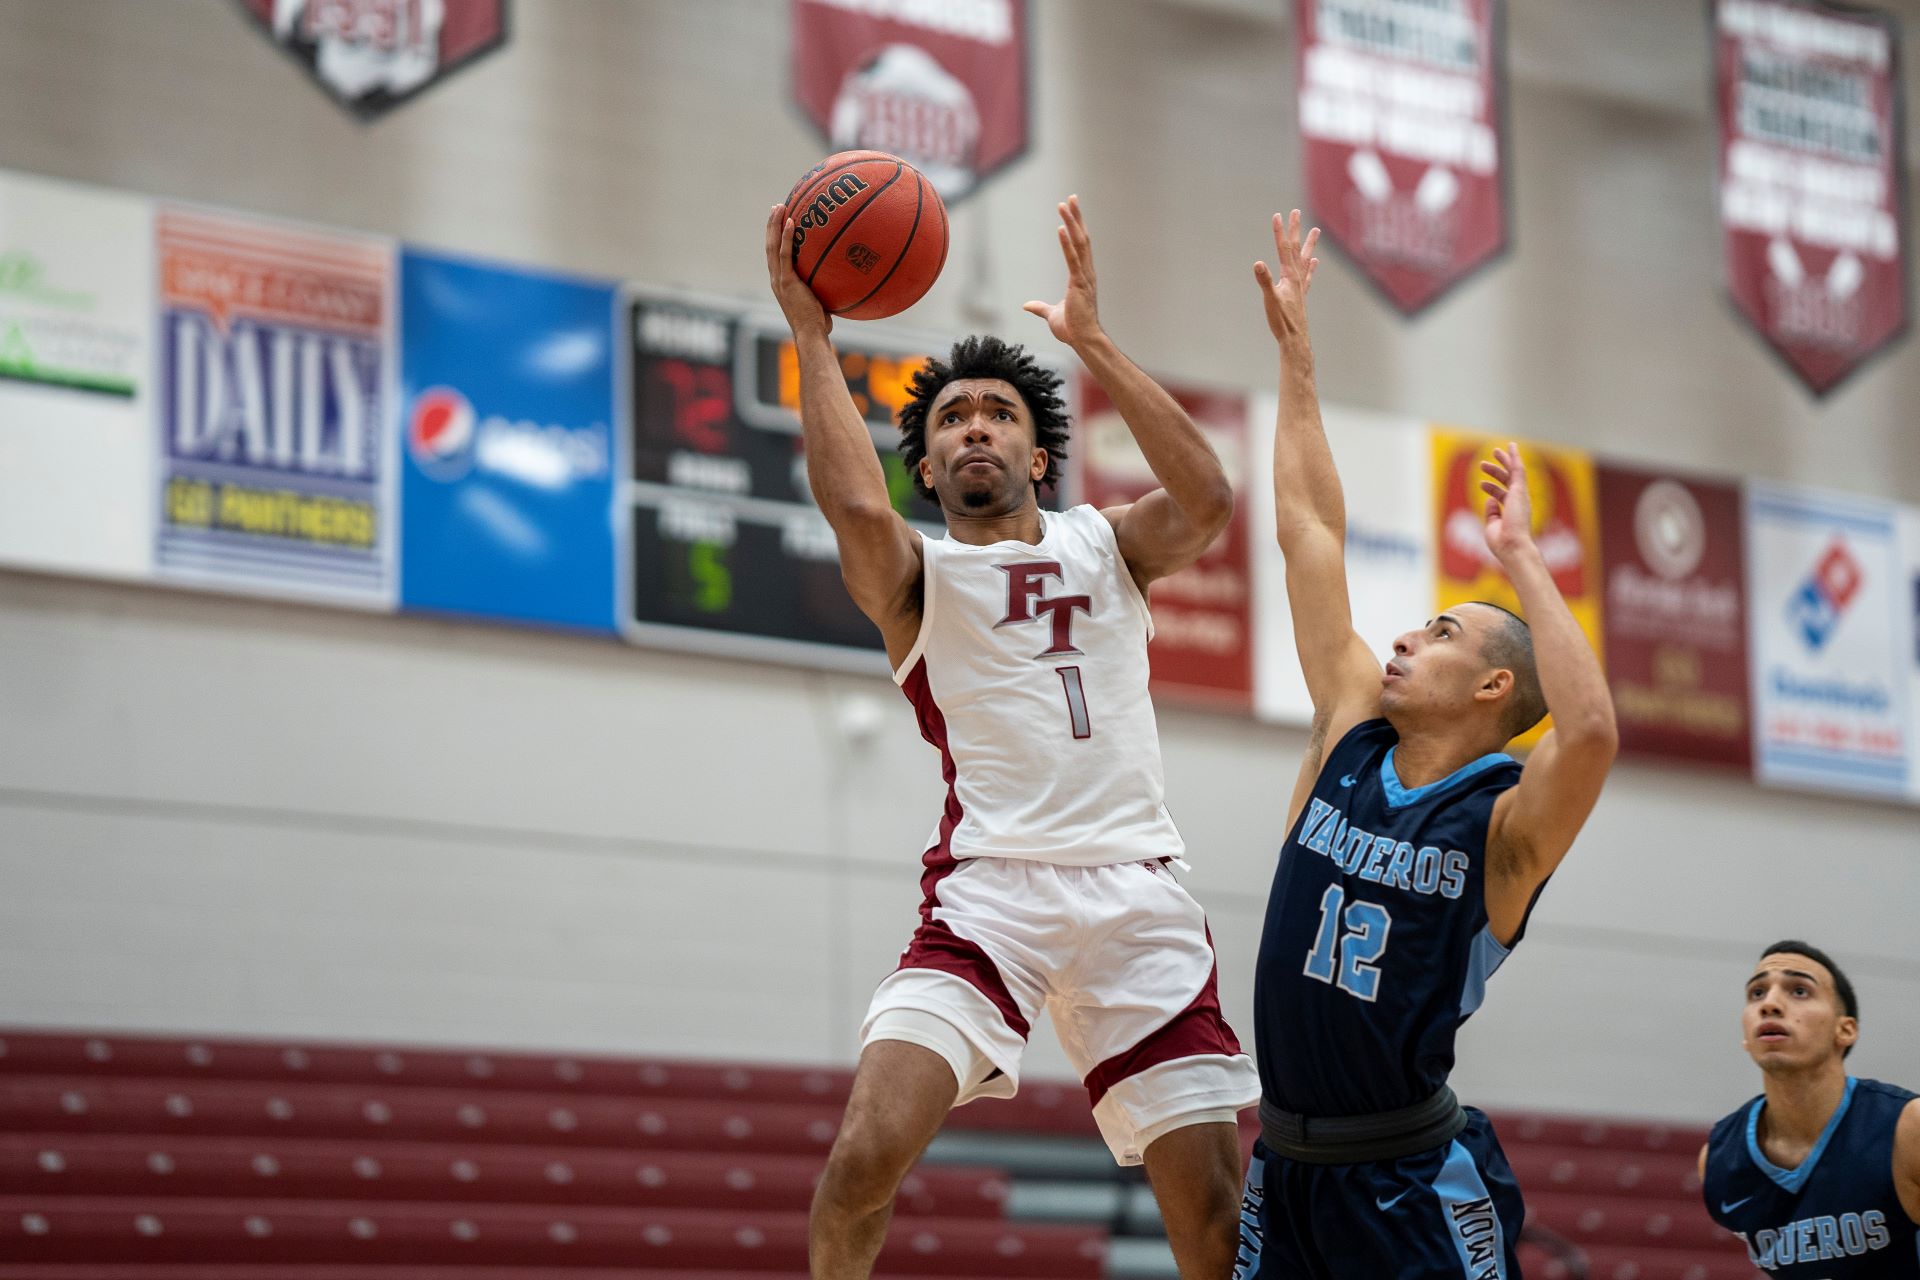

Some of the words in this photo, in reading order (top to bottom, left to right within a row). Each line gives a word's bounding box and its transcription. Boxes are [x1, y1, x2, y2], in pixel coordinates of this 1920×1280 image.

[174, 316, 374, 477] DAILY
[1055, 666, 1091, 739] 1
[1298, 797, 1469, 899] VAQUEROS
[1303, 883, 1392, 1003] 12
[1733, 1209, 1891, 1270] QUEROS
